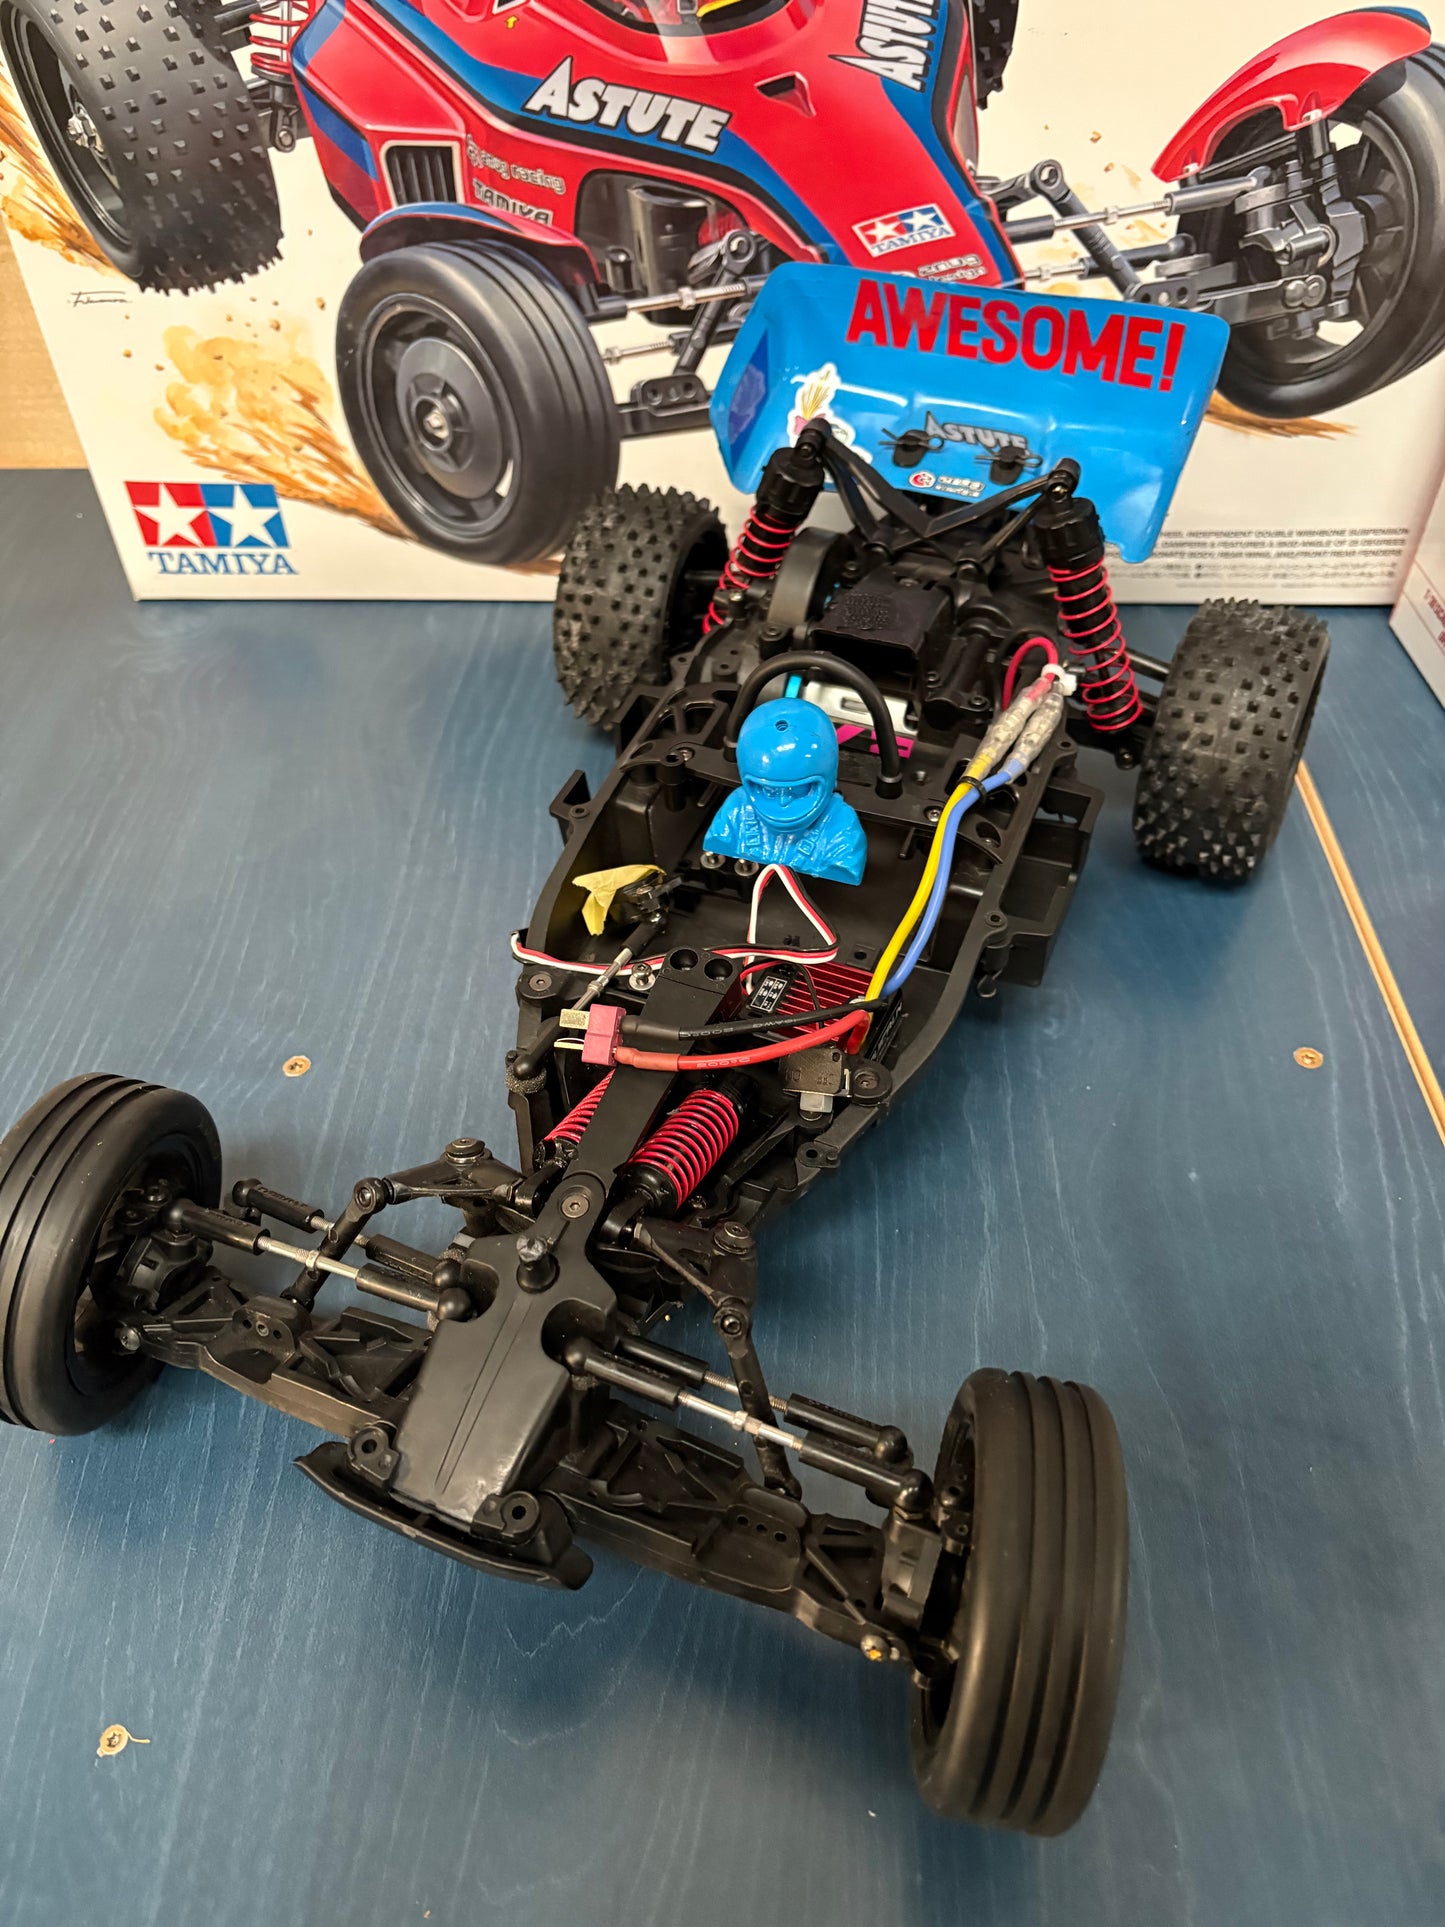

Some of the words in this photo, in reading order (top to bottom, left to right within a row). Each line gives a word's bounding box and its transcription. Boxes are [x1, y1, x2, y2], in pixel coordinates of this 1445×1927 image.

[828, 0, 938, 93] ASTUT
[521, 54, 733, 155] ASTUTE
[473, 178, 553, 226] TAMIYA
[871, 227, 951, 253] TAMIYA
[845, 278, 1186, 392] AWESOME!
[925, 410, 1030, 454] ASTUTE
[147, 551, 299, 576] TAMIYA
